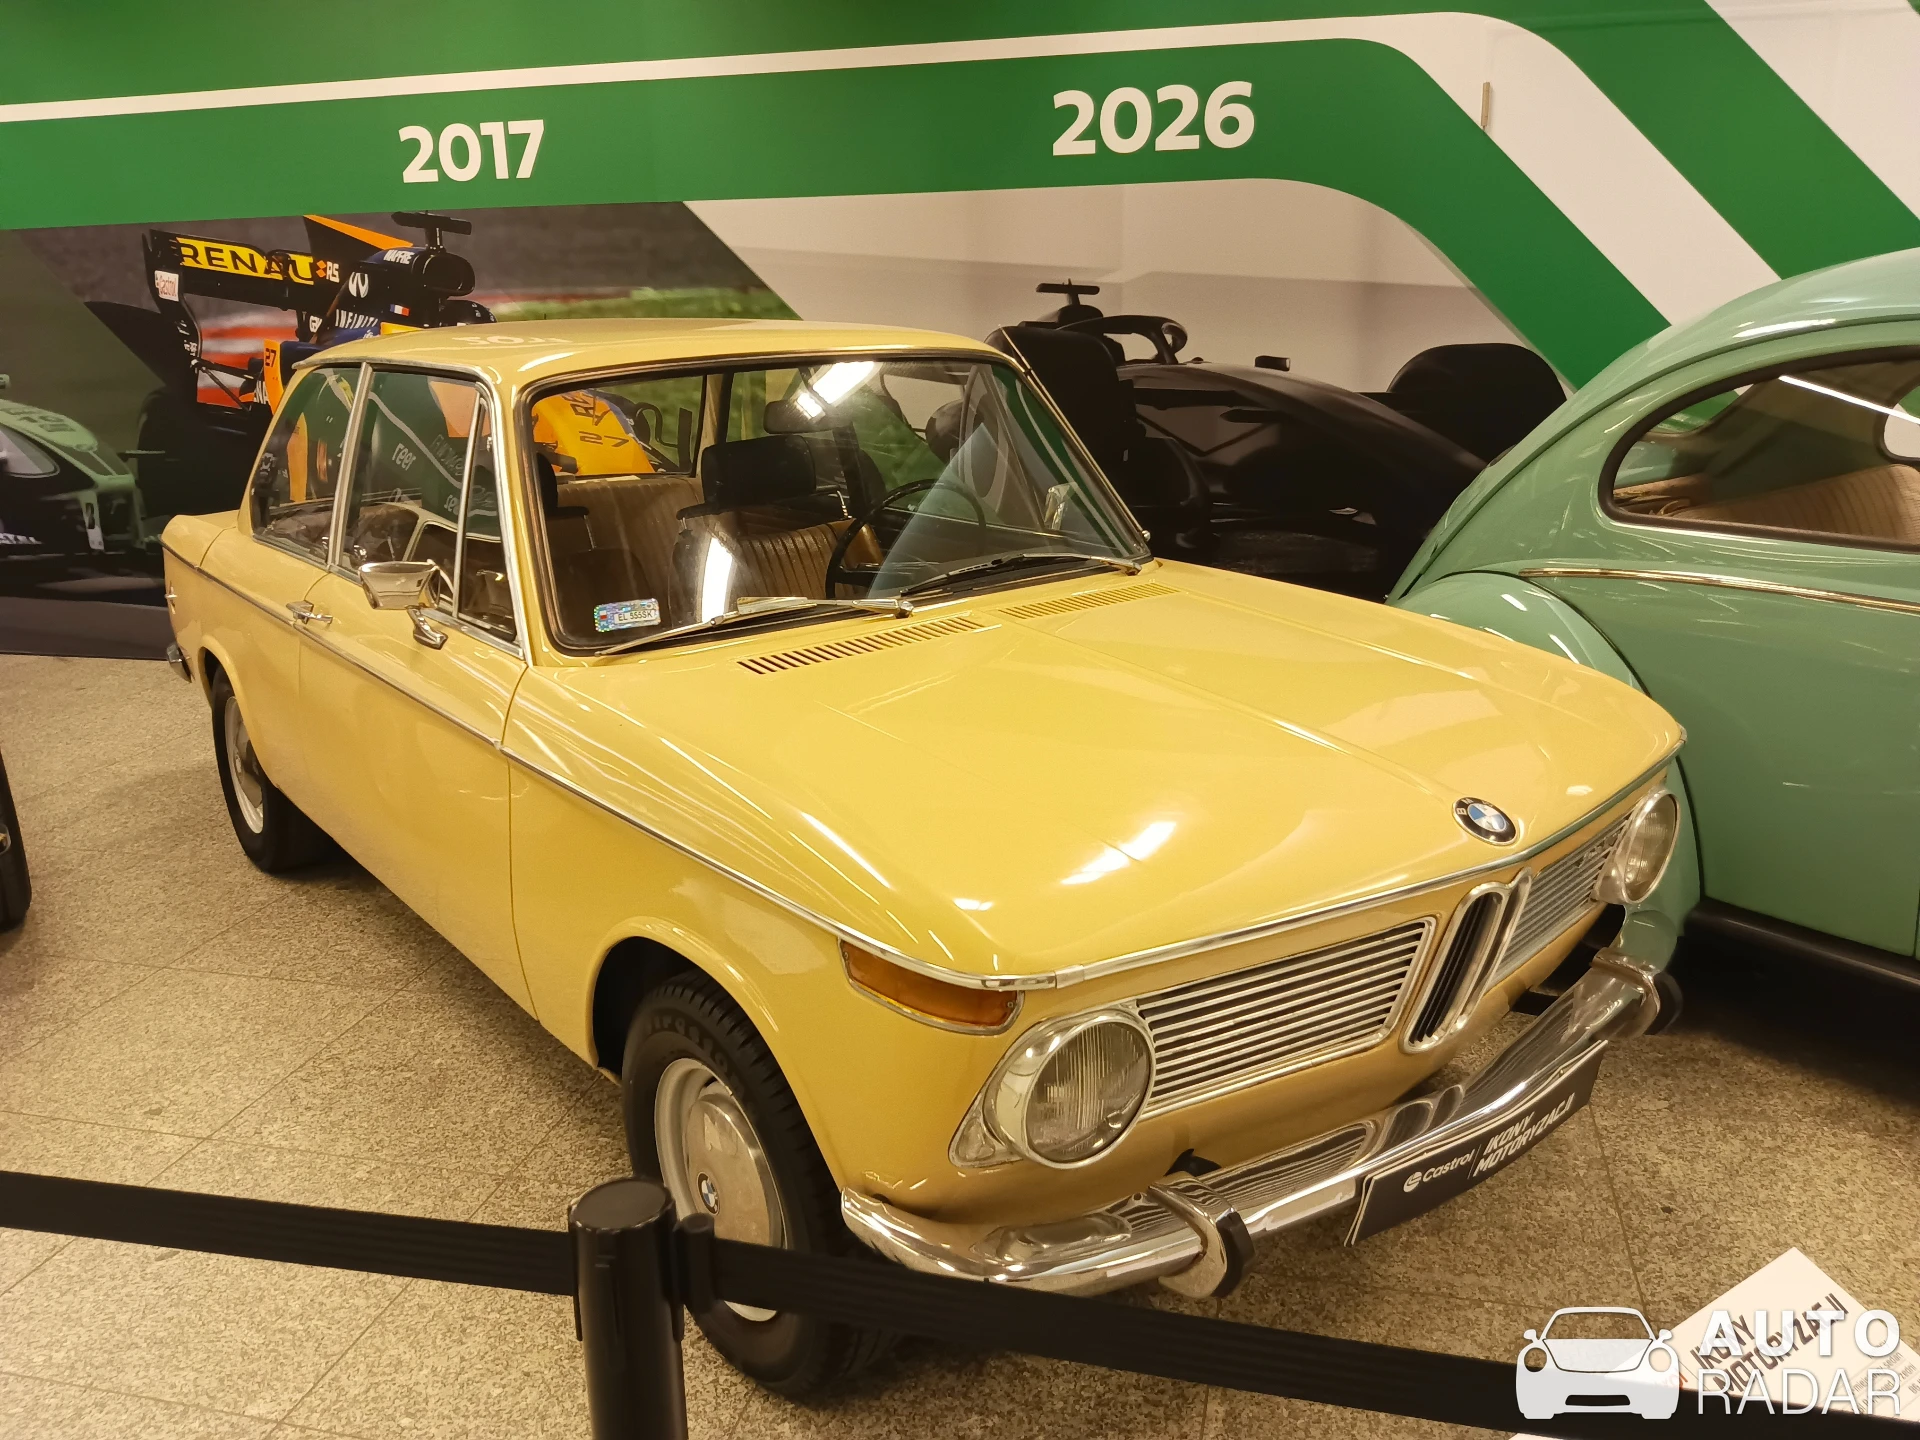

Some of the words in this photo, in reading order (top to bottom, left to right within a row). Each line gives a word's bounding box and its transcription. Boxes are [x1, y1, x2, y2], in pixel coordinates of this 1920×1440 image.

[1051, 80, 1256, 156] 2026
[398, 118, 545, 184] 2017
[326, 260, 340, 283] RS
[264, 347, 277, 368] 27
[579, 431, 630, 448] 27
[618, 613, 628, 622] EL
[1473, 1092, 1576, 1177] MOTORYZACJI
[1483, 1111, 1535, 1156] IKONY
[1422, 1149, 1475, 1183] Castrol
